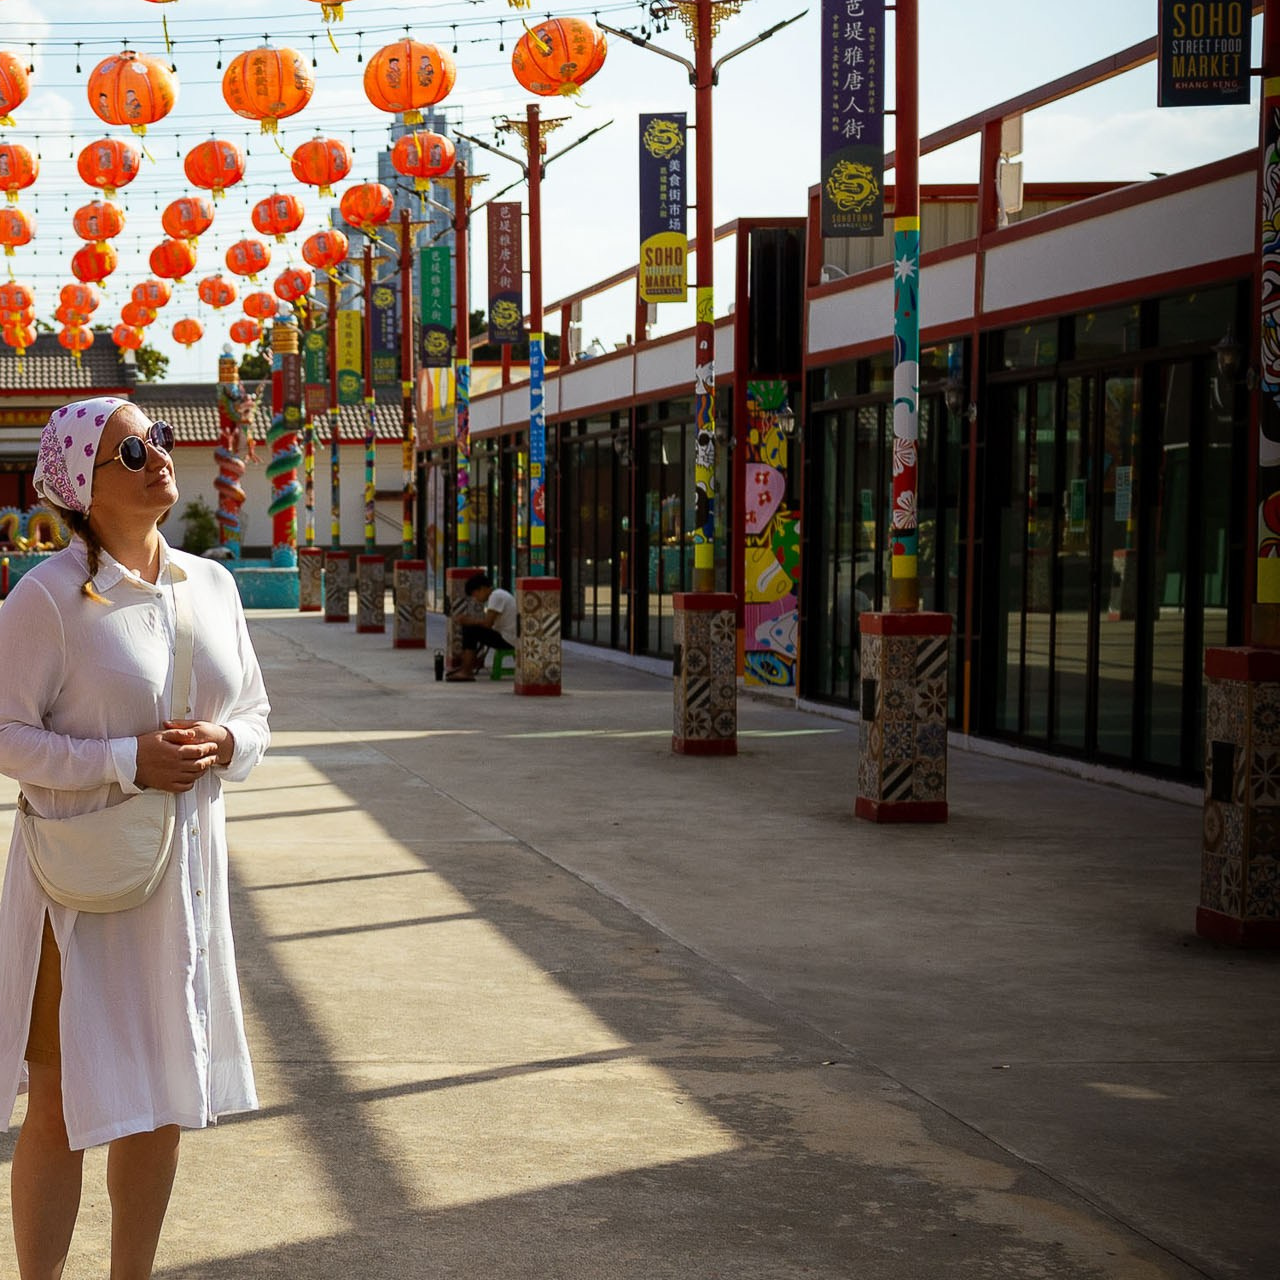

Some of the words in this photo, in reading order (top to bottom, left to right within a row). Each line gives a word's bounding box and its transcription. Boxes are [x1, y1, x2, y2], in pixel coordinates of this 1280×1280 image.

[1173, 2, 1243, 38] SOHO
[1172, 39, 1211, 55] STREET
[1214, 38, 1243, 54] FOOD
[1172, 54, 1240, 79] MARKET
[669, 160, 681, 231] 美食街市场
[645, 247, 682, 267] SOHO
[645, 275, 682, 288] MARKET
